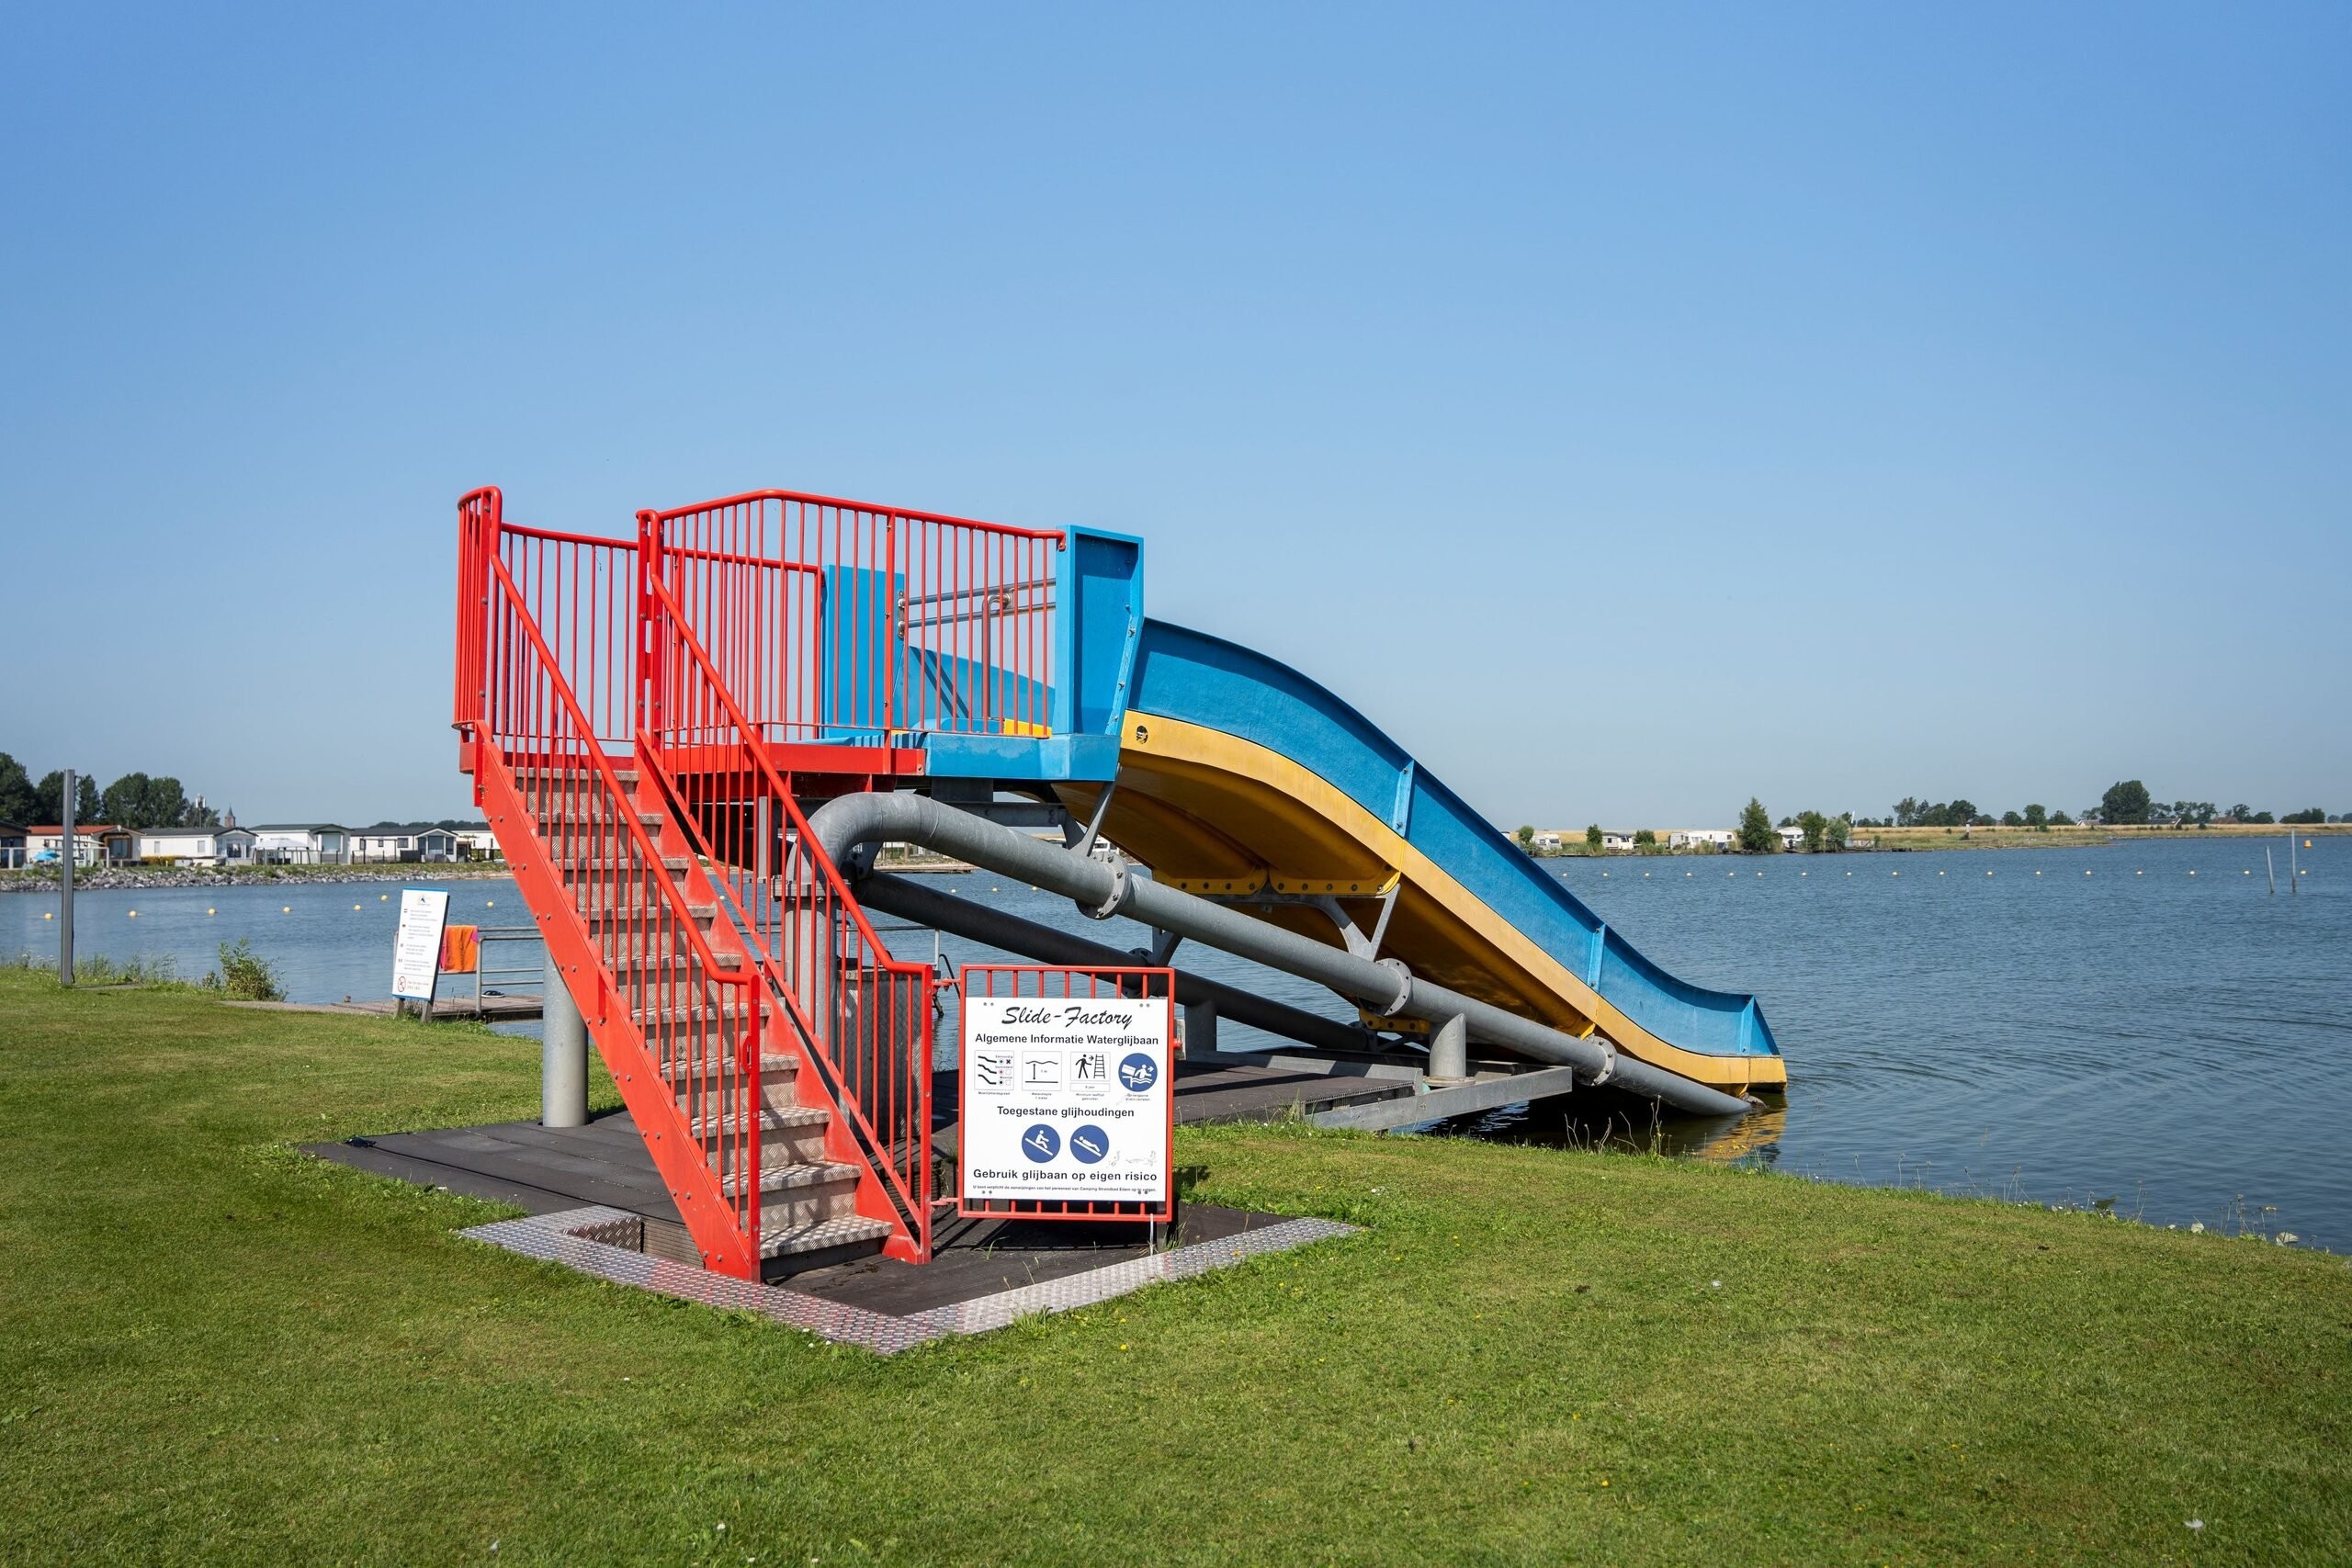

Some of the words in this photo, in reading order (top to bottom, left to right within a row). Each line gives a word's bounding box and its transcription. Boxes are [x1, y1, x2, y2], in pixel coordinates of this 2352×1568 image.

[1001, 1007, 1132, 1030] Slide-Factory
[976, 1033, 1027, 1044] Algemene
[1031, 1034, 1083, 1043] Informatie
[1087, 1035, 1159, 1046] Waterglijbaan
[997, 1106, 1057, 1117] Toegestane
[1061, 1107, 1134, 1119] glijhoudingen
[974, 1169, 1018, 1179] Gebruik
[1023, 1170, 1067, 1180] glijbaan
[1072, 1173, 1085, 1181] op
[1090, 1171, 1121, 1182] eigen
[1125, 1171, 1157, 1180] risico
